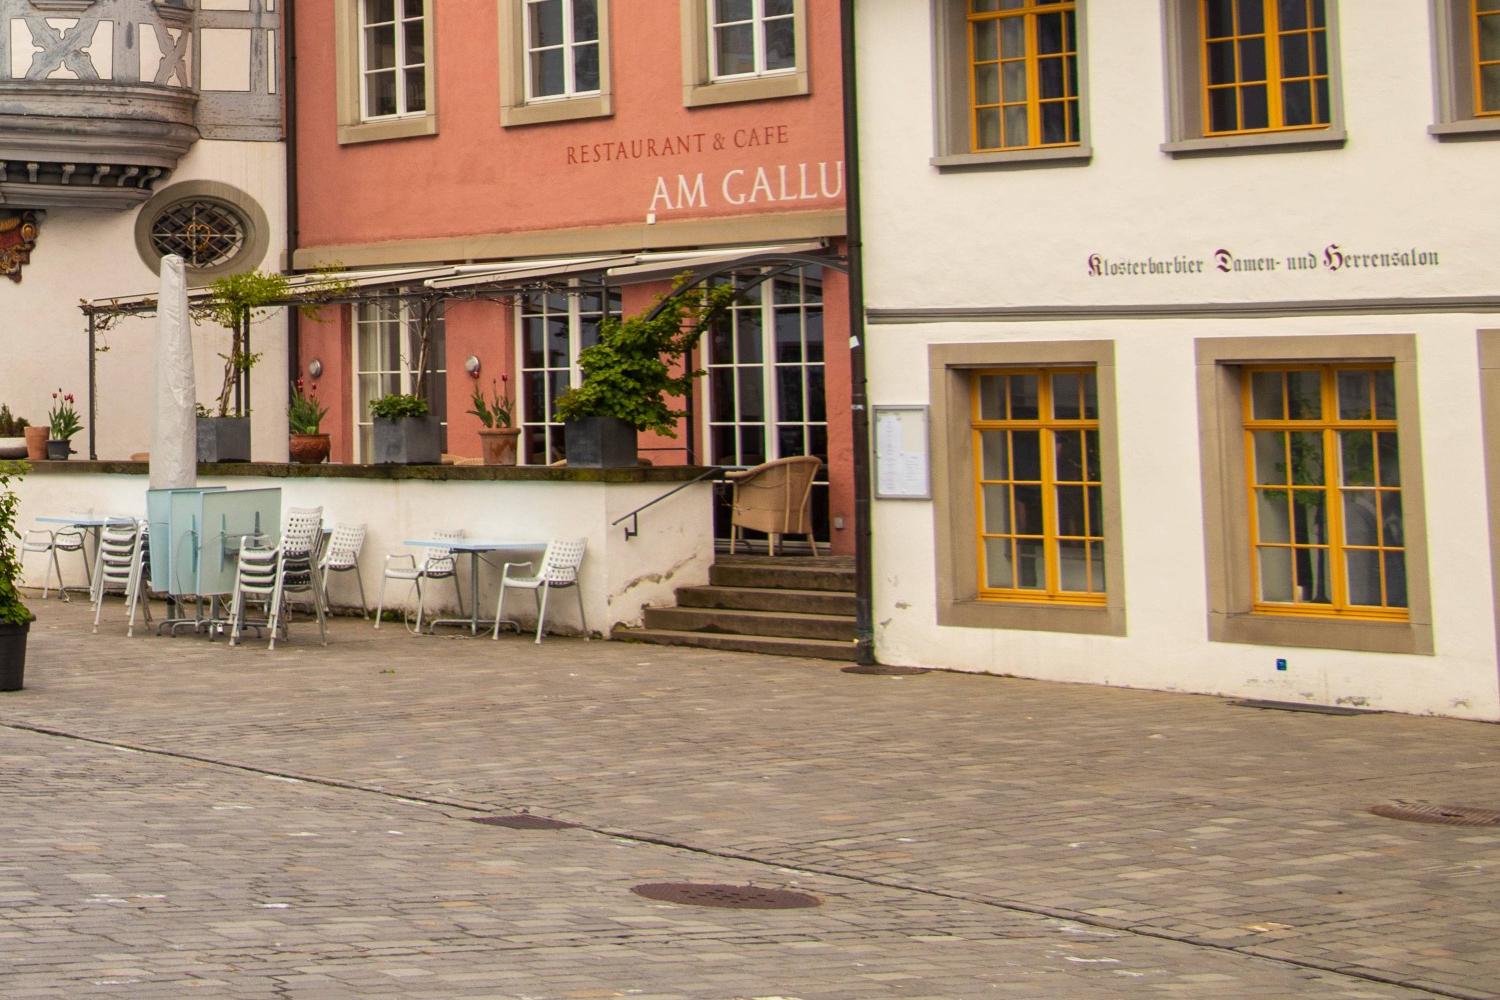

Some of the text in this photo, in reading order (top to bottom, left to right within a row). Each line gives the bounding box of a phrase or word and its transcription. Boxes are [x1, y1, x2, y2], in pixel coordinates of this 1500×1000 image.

[567, 125, 789, 164] RESTAURANT & CAFE
[649, 161, 843, 211] AM GALLU
[1088, 244, 1439, 277] Klosterbarbier Damen- und Herrensalon
